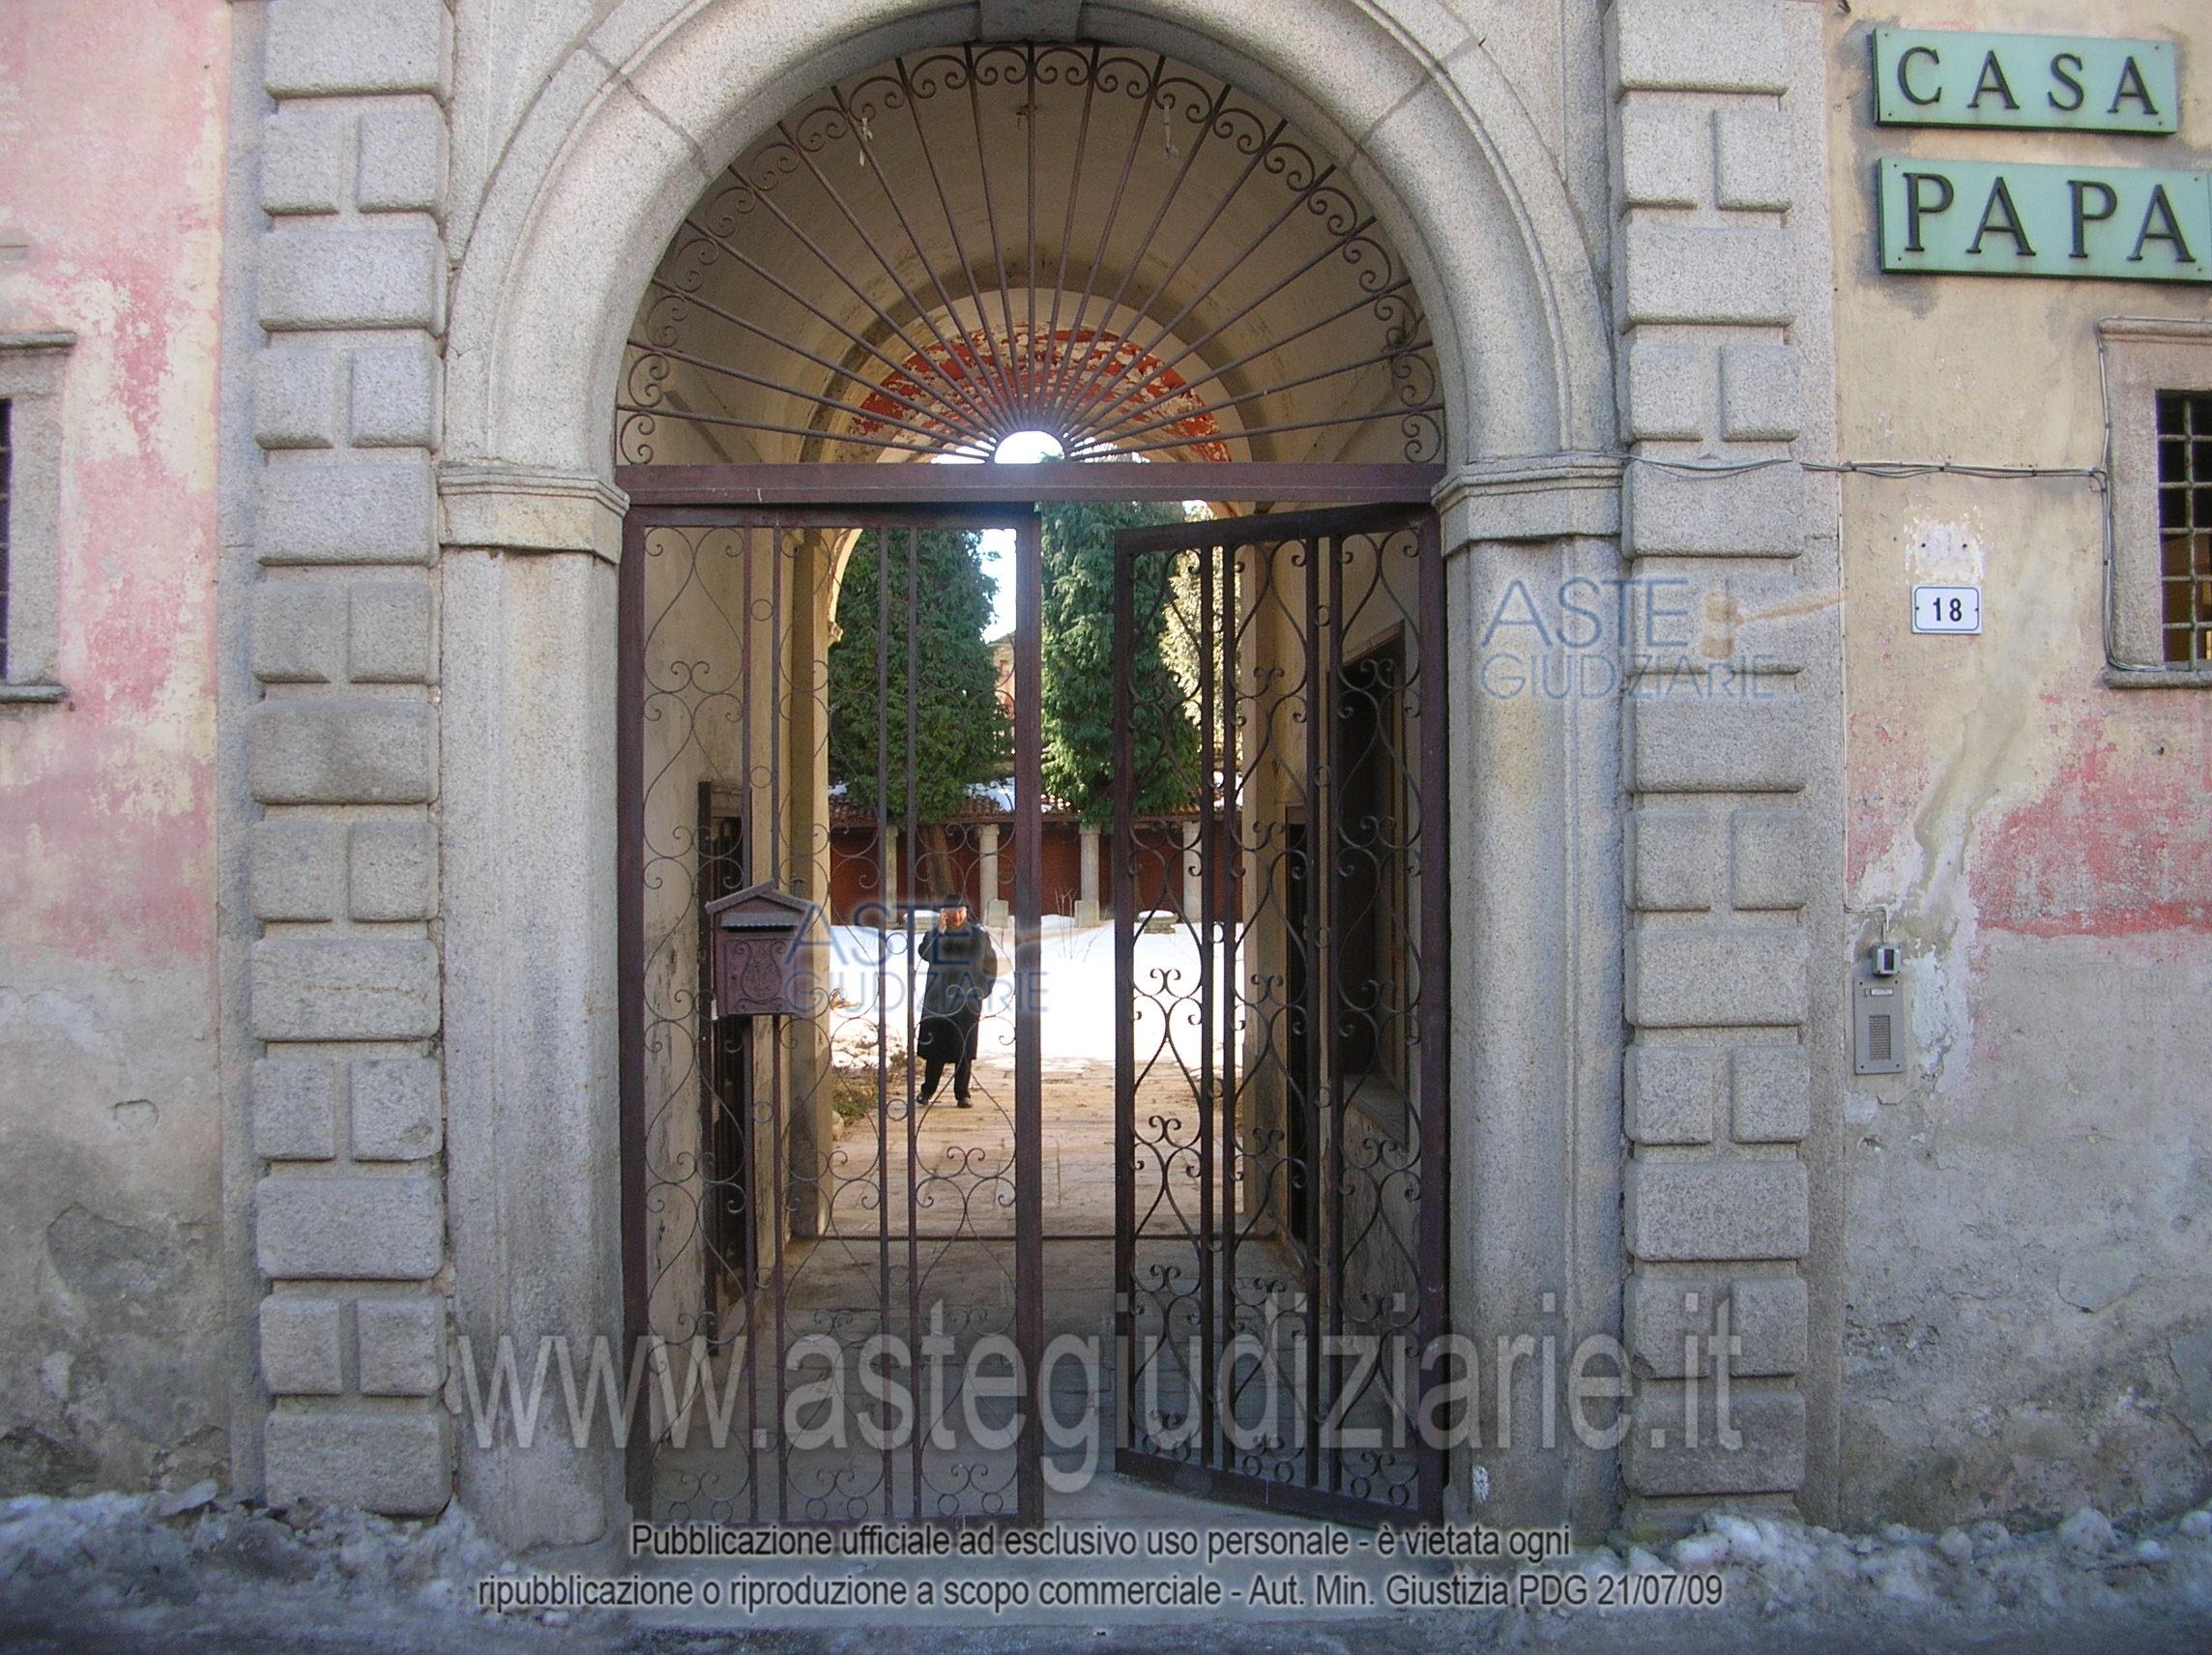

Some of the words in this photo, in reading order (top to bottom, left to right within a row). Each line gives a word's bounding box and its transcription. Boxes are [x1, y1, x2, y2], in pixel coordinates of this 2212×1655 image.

[1897, 46, 2159, 115] CASA
[1903, 172, 2196, 263] PAPA
[1933, 596, 1963, 623] 18
